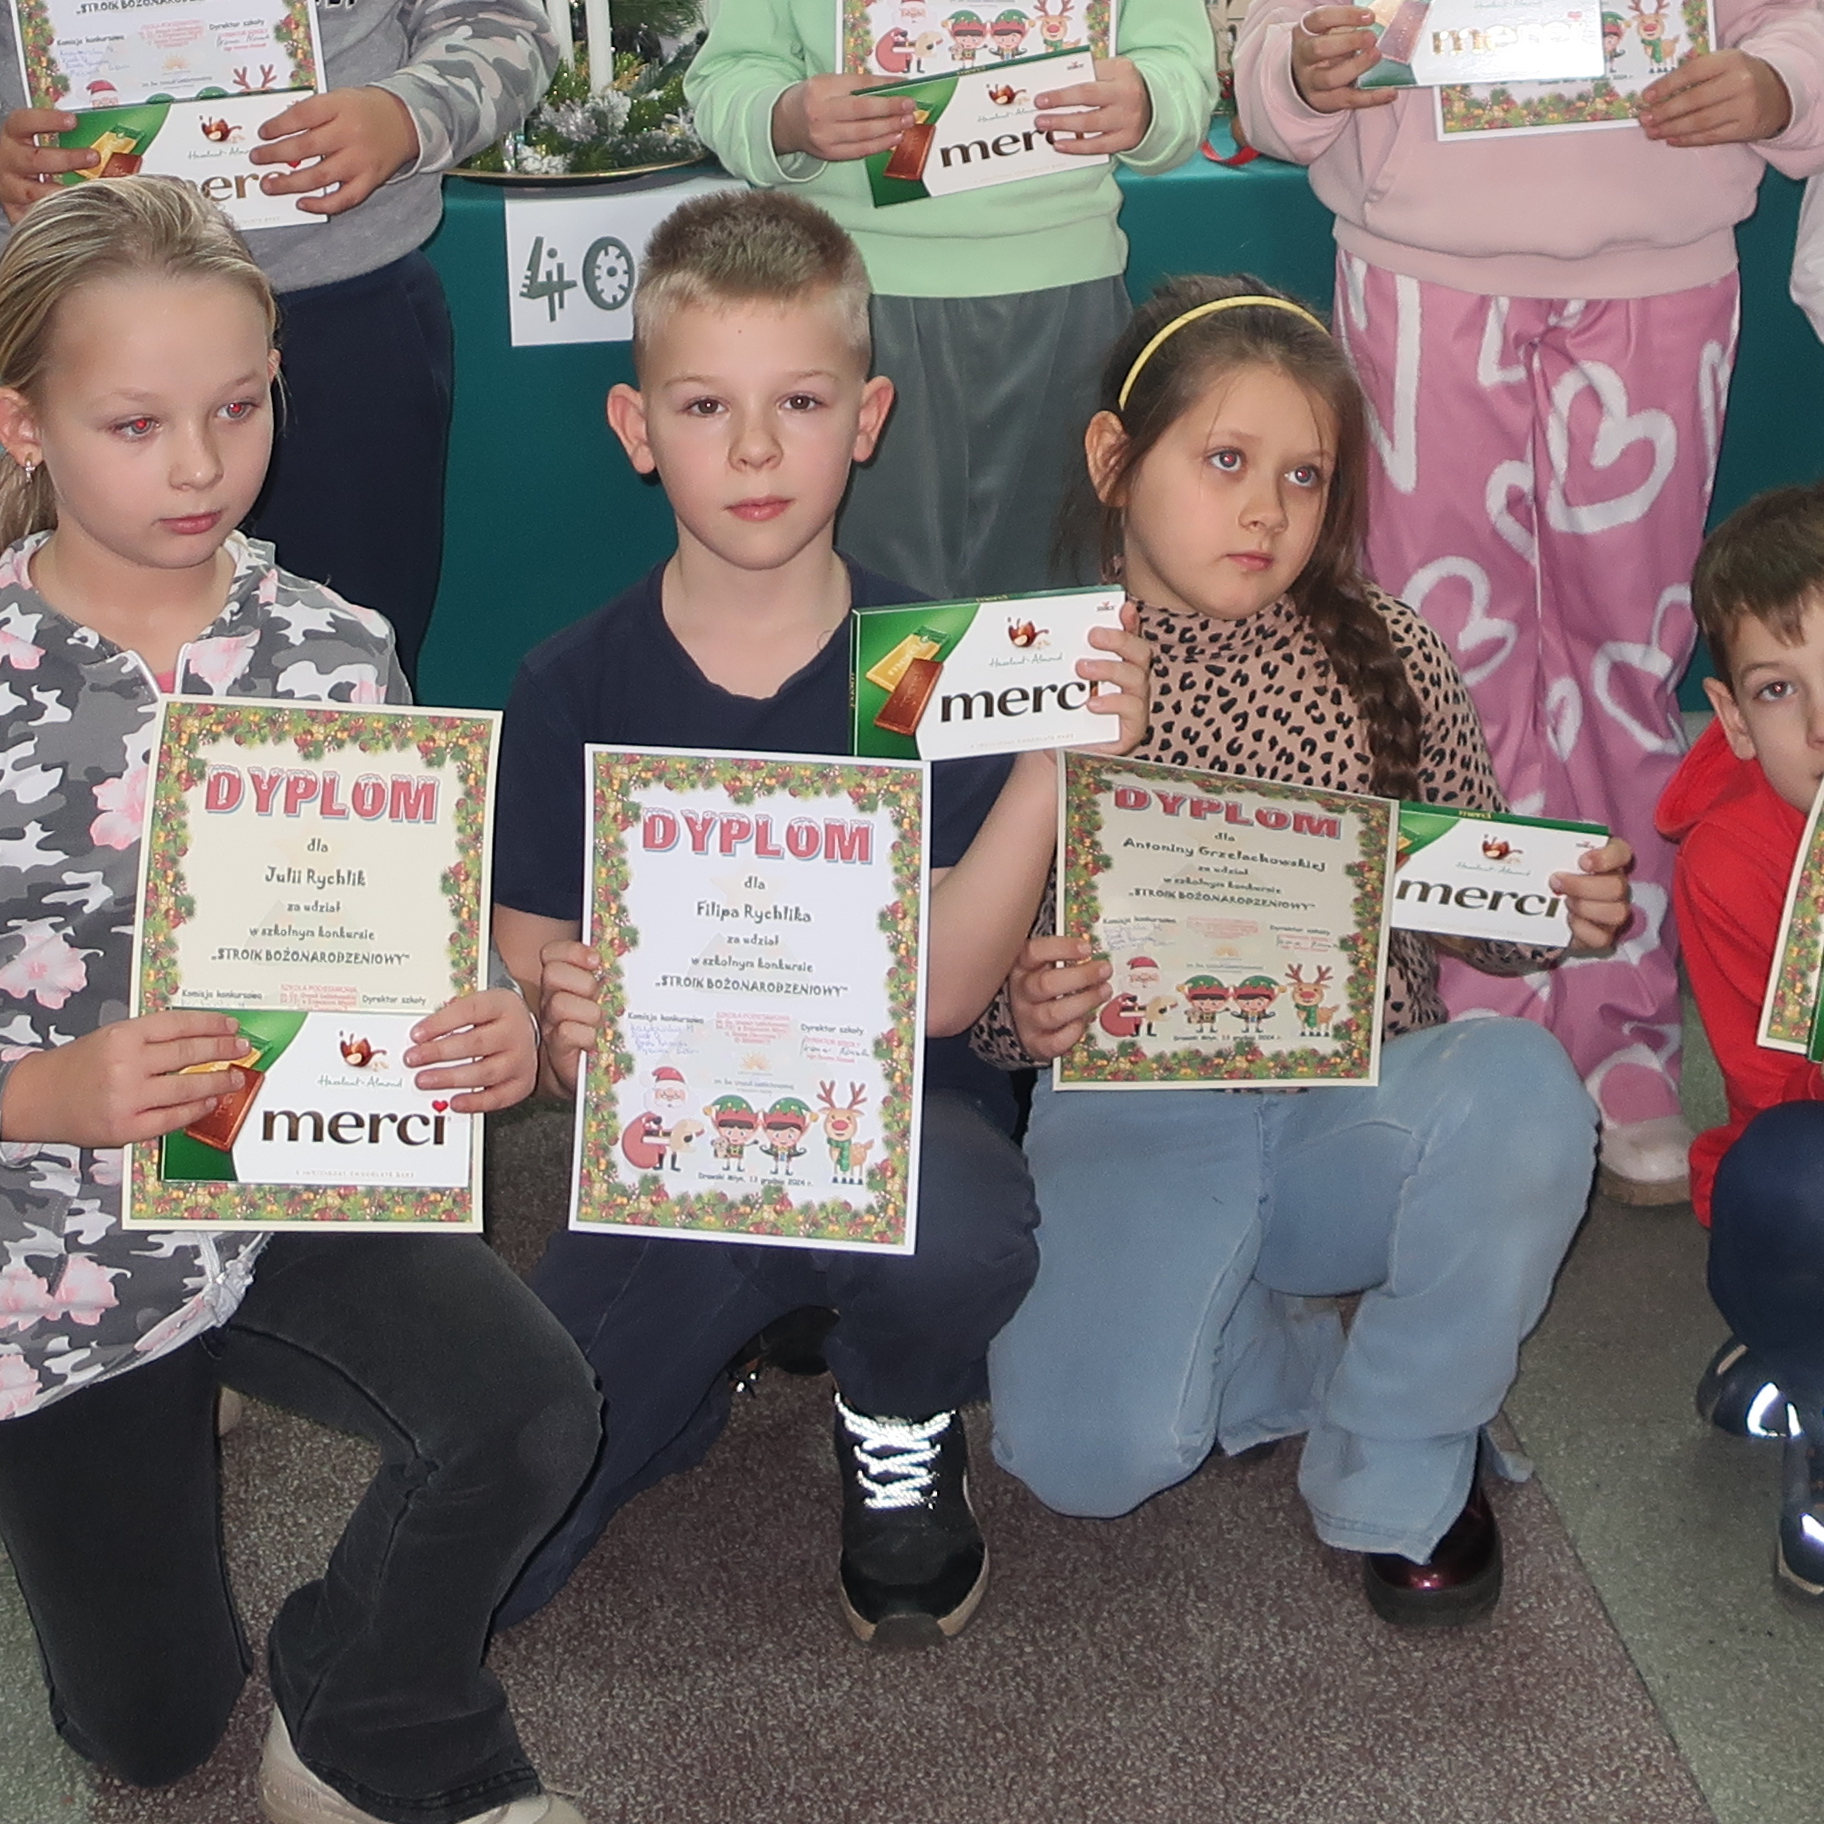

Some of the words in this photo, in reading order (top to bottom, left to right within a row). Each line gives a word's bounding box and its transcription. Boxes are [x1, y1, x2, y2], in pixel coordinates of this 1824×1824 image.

[940, 128, 1056, 168] merc
[203, 171, 290, 202] erc
[519, 235, 636, 323] 40
[205, 764, 441, 824] DYPLOM
[1113, 785, 1341, 840] DYPLOM
[307, 838, 329, 853] dla
[642, 807, 874, 866] DYPLOM
[1123, 837, 1194, 858] Antoniny
[1215, 832, 1236, 842] dla
[265, 865, 302, 884] Julii
[306, 869, 366, 890] Rychlik
[744, 875, 766, 890] dla
[287, 903, 300, 912] za
[303, 900, 340, 913] udział
[1395, 878, 1563, 918] merci
[696, 900, 740, 920] Filipa
[743, 904, 812, 924] Rychlika
[249, 927, 258, 936] w
[261, 924, 315, 940] szkolnym
[318, 926, 375, 940] konkursie
[727, 936, 741, 945] za
[743, 934, 780, 946] udział
[691, 957, 700, 966] w
[702, 955, 755, 971] szkolnym
[757, 959, 813, 973] konkursie
[362, 994, 400, 1005] Dyrektor
[262, 1100, 449, 1146] merci
